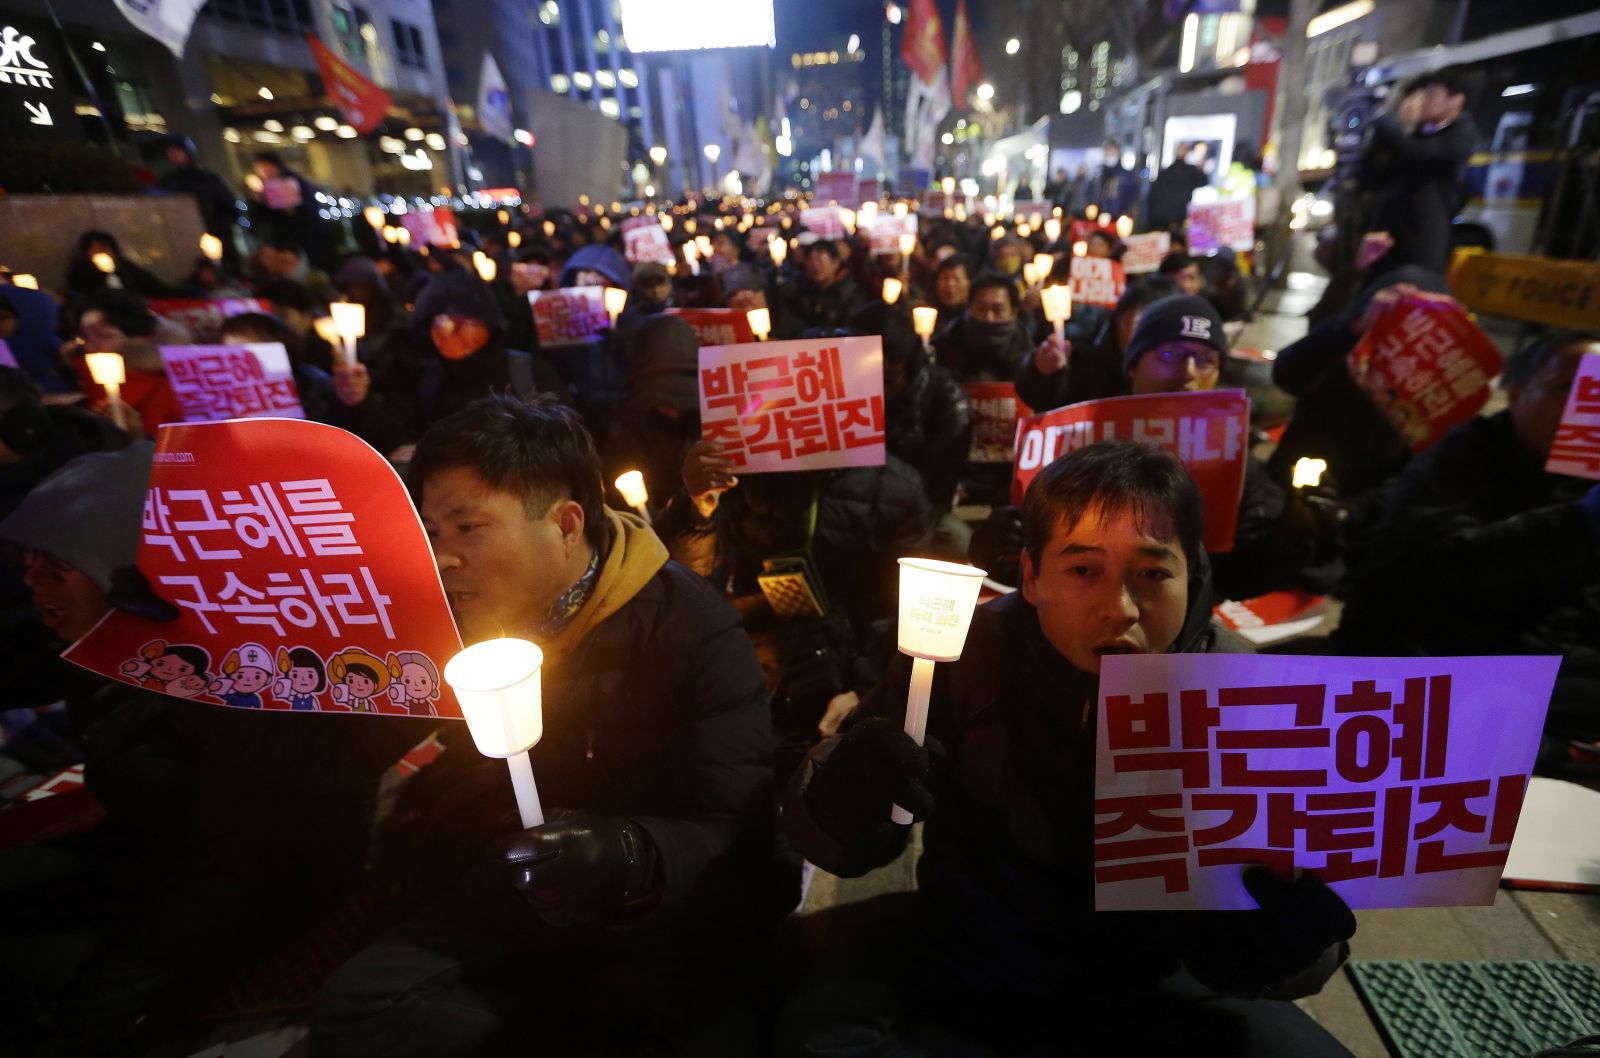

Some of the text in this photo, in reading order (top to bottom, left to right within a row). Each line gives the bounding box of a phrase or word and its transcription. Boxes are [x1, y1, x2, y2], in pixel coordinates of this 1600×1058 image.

[169, 351, 265, 388] 박근혜
[702, 346, 846, 416] 박근혜
[142, 478, 364, 562] 박근혜를
[157, 566, 397, 640] 구속하라
[1105, 674, 1453, 789] 박근혜
[1095, 773, 1527, 894] 즉각퇴진
